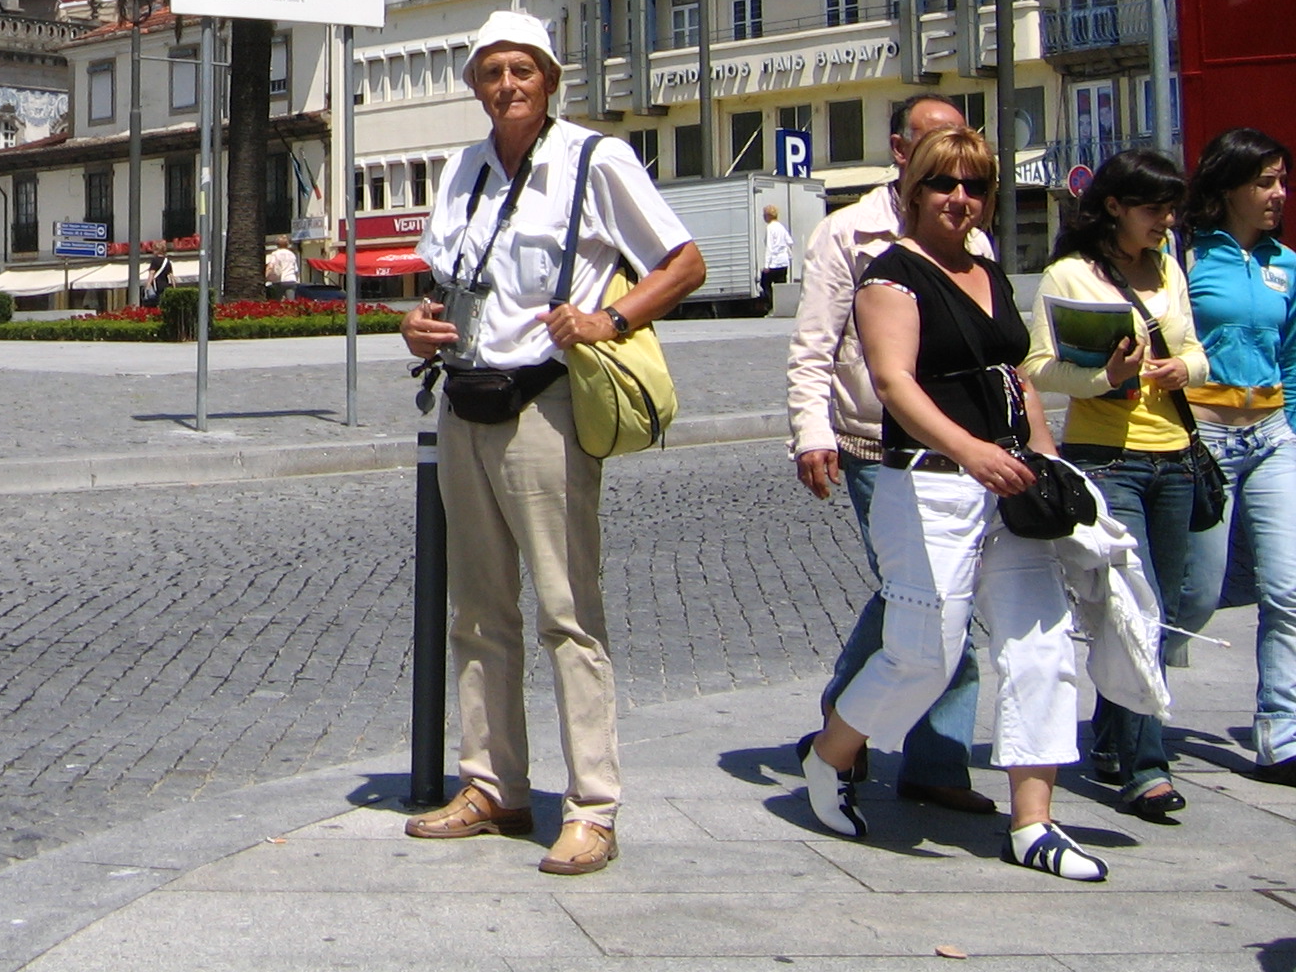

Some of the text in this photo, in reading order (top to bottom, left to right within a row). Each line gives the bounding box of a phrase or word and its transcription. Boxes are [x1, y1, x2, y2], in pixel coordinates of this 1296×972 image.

[761, 54, 805, 73] MAIS
[816, 41, 899, 66] BARATO
[785, 136, 806, 177] P
